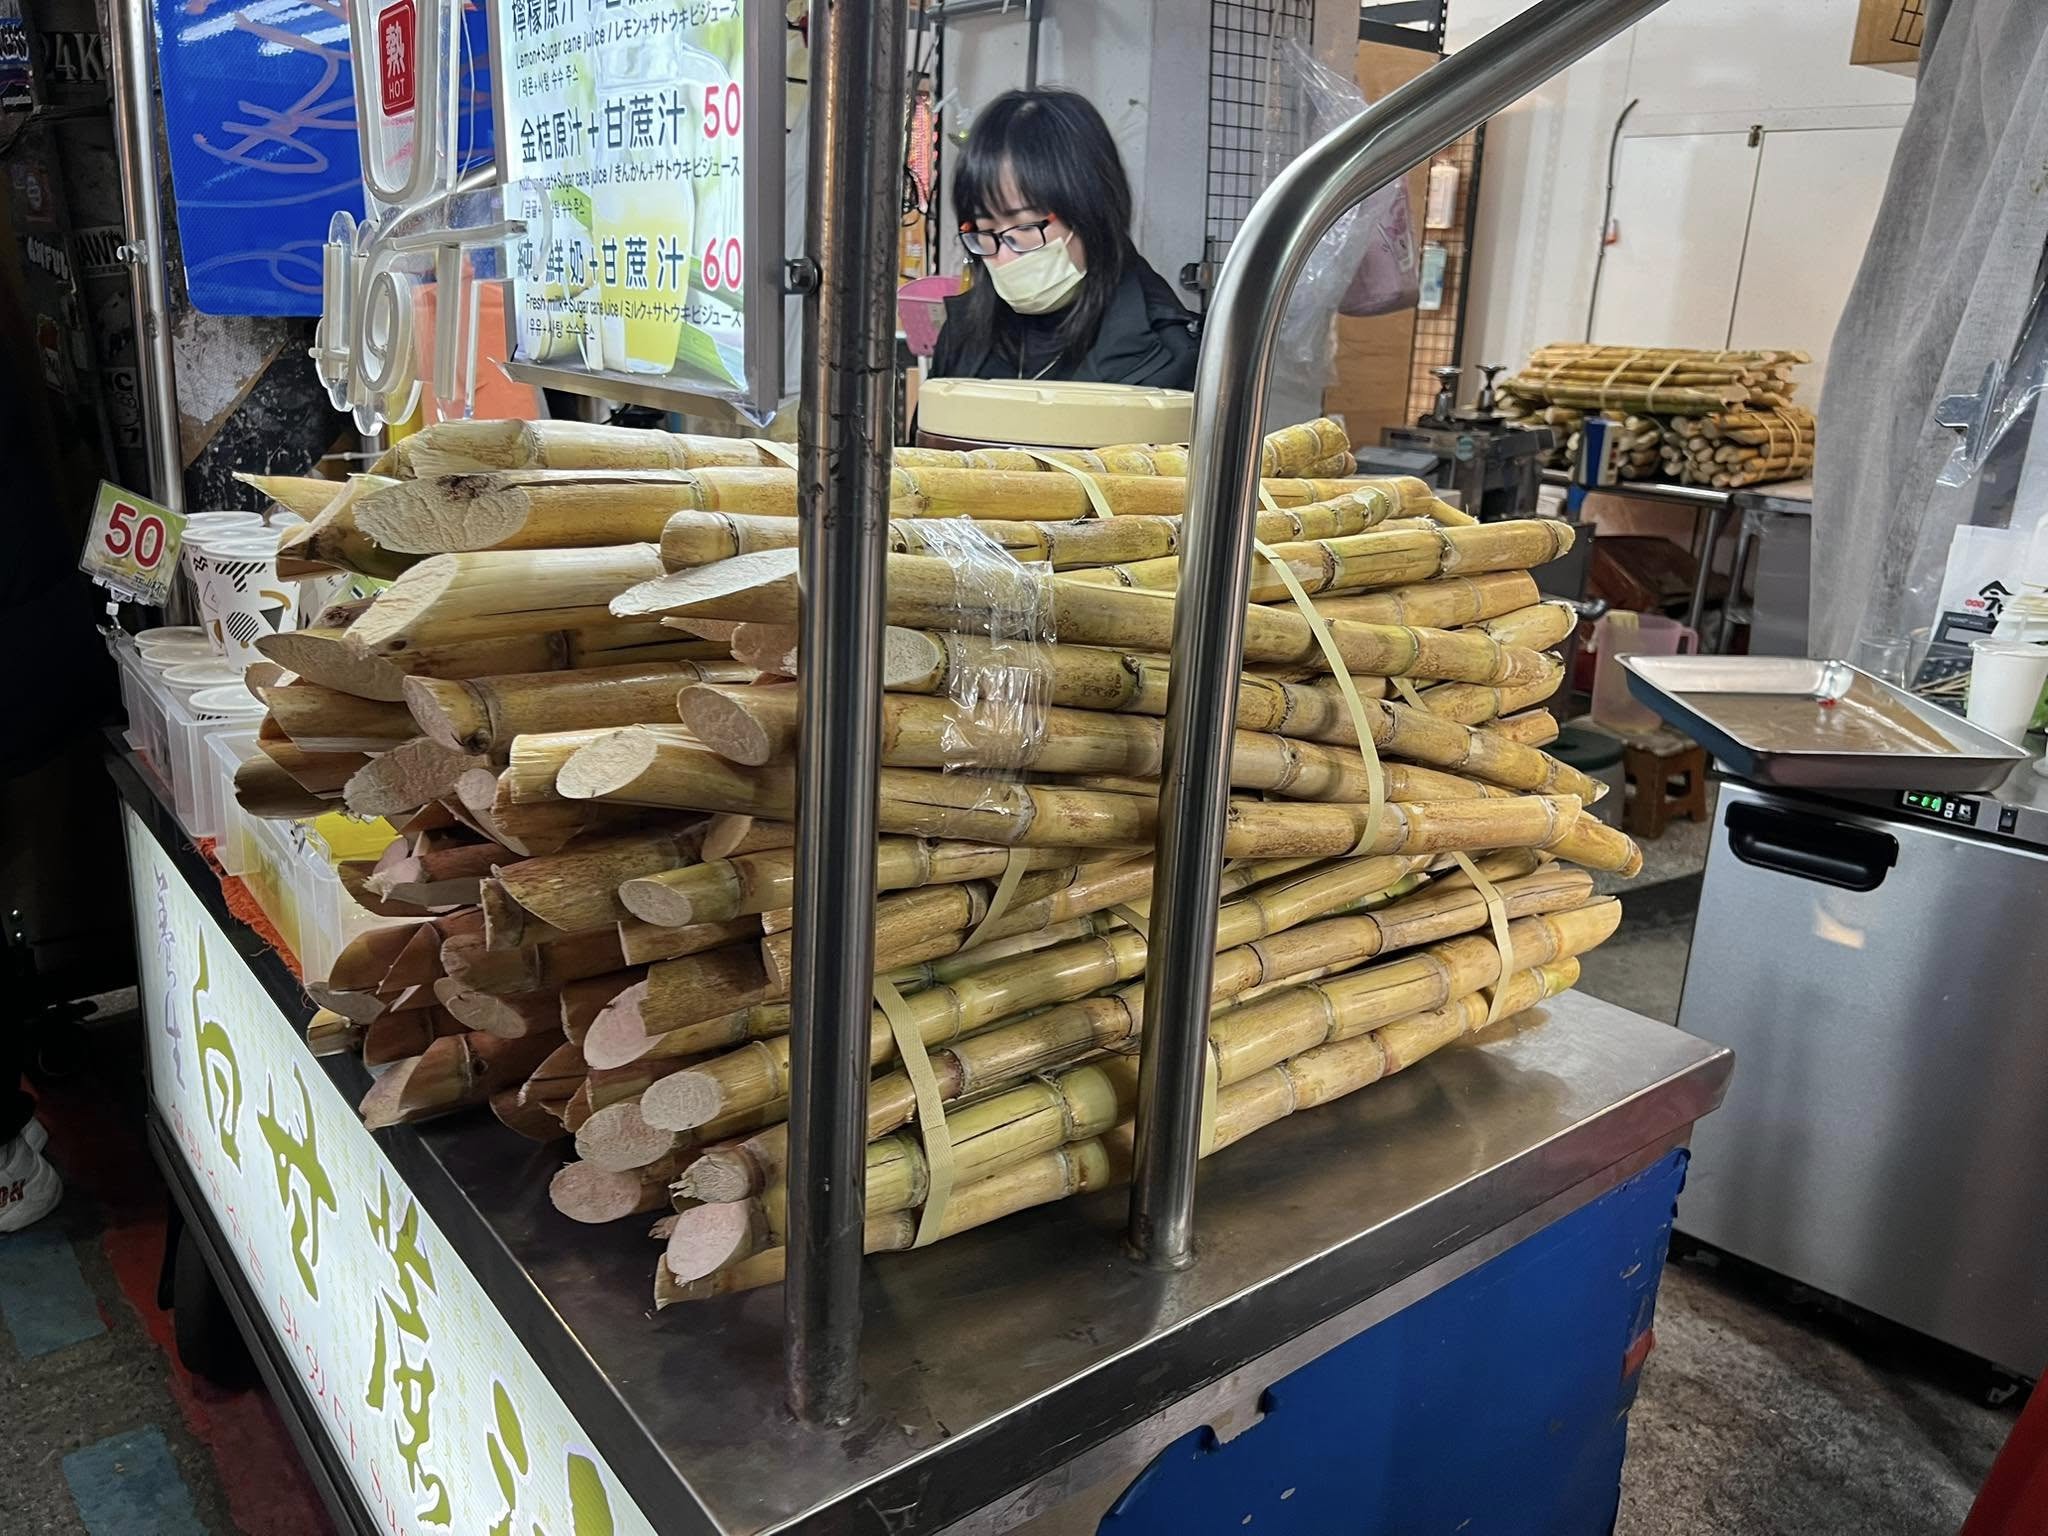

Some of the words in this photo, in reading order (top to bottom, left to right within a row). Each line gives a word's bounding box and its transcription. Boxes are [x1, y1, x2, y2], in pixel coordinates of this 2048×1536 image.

[386, 20, 406, 79] 熱
[564, 35, 582, 54] cane
[584, 27, 606, 53] juice
[388, 78, 406, 100] HOT
[704, 83, 741, 138] 50
[703, 238, 741, 289] 60
[105, 502, 165, 568] 50
